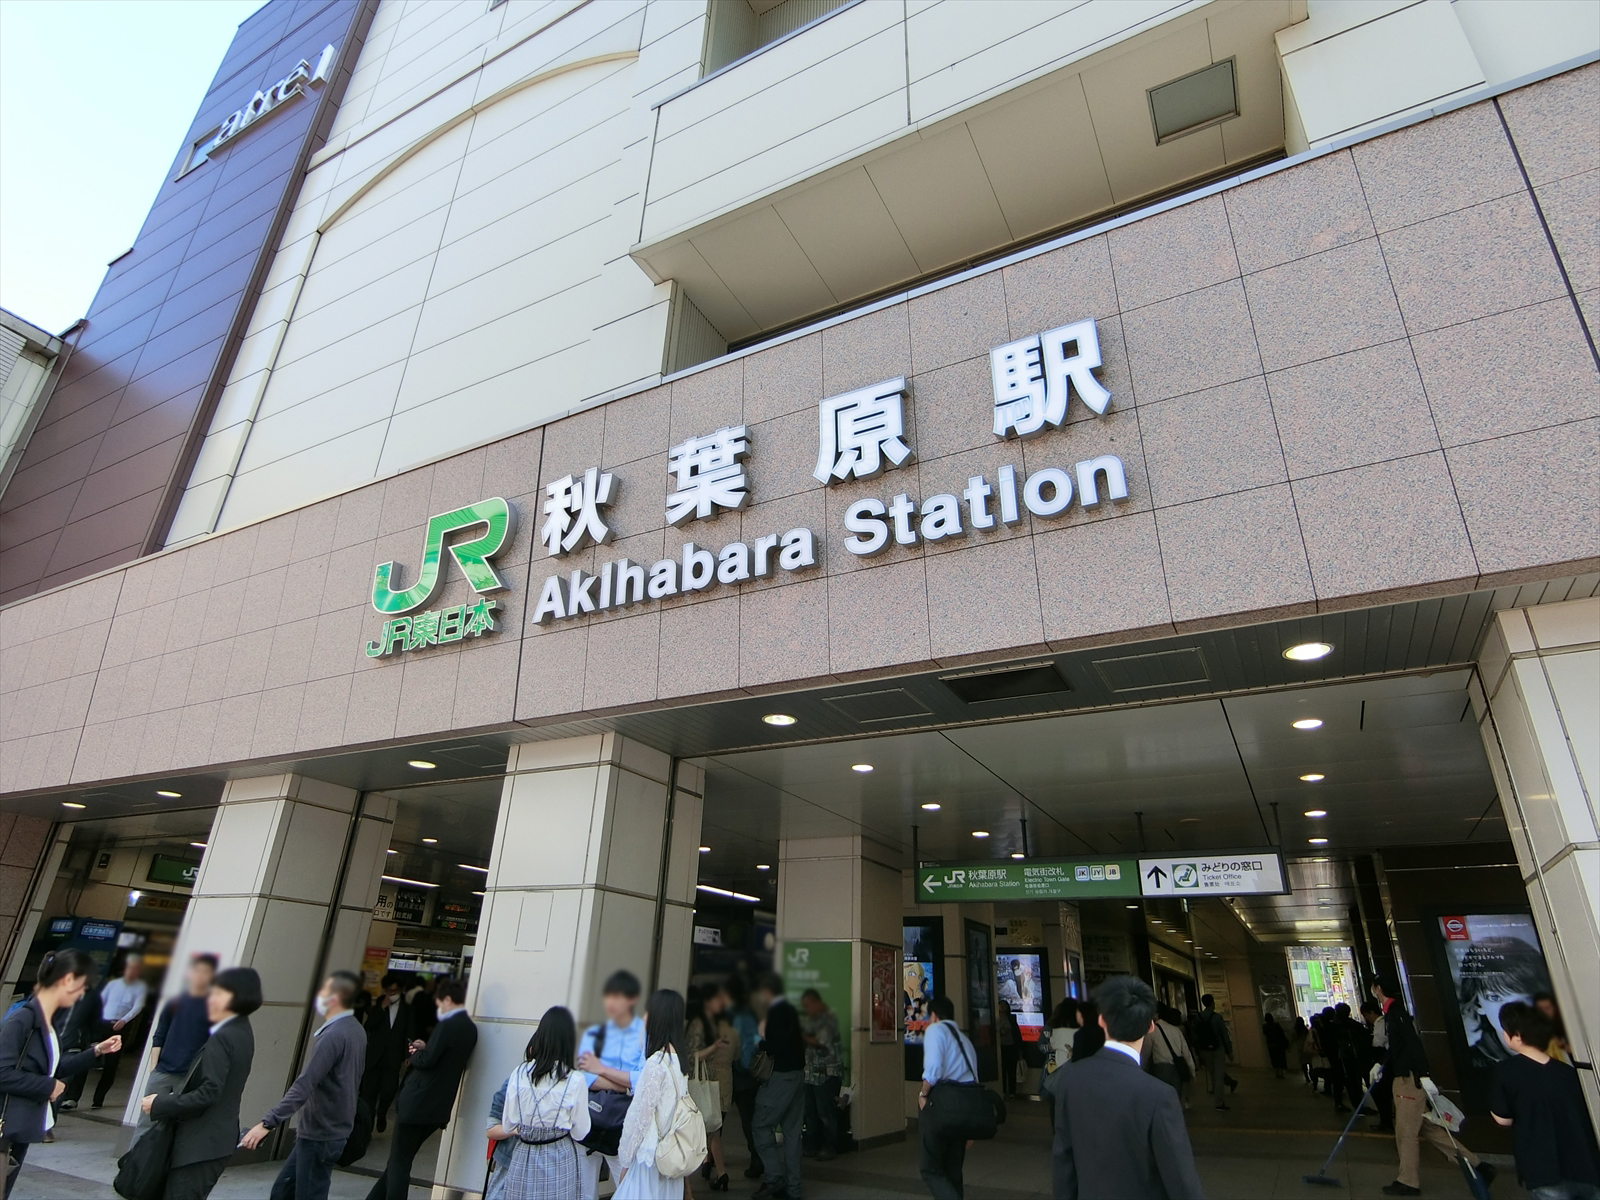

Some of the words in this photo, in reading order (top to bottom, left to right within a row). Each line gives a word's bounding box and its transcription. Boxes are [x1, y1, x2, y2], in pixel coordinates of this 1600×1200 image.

[541, 317, 1113, 559] 秋葉原駅
[532, 526, 818, 626] Akihabara
[843, 454, 1130, 558] Station
[371, 496, 515, 615] JR
[366, 597, 501, 659] JR東日本
[1023, 866, 1065, 877] 電気街改札
[1201, 860, 1263, 873] みどりの窓口
[944, 870, 966, 884] JR
[968, 869, 1007, 881] 秋葉原駅
[999, 880, 1020, 888] Station
[787, 948, 810, 963] JR
